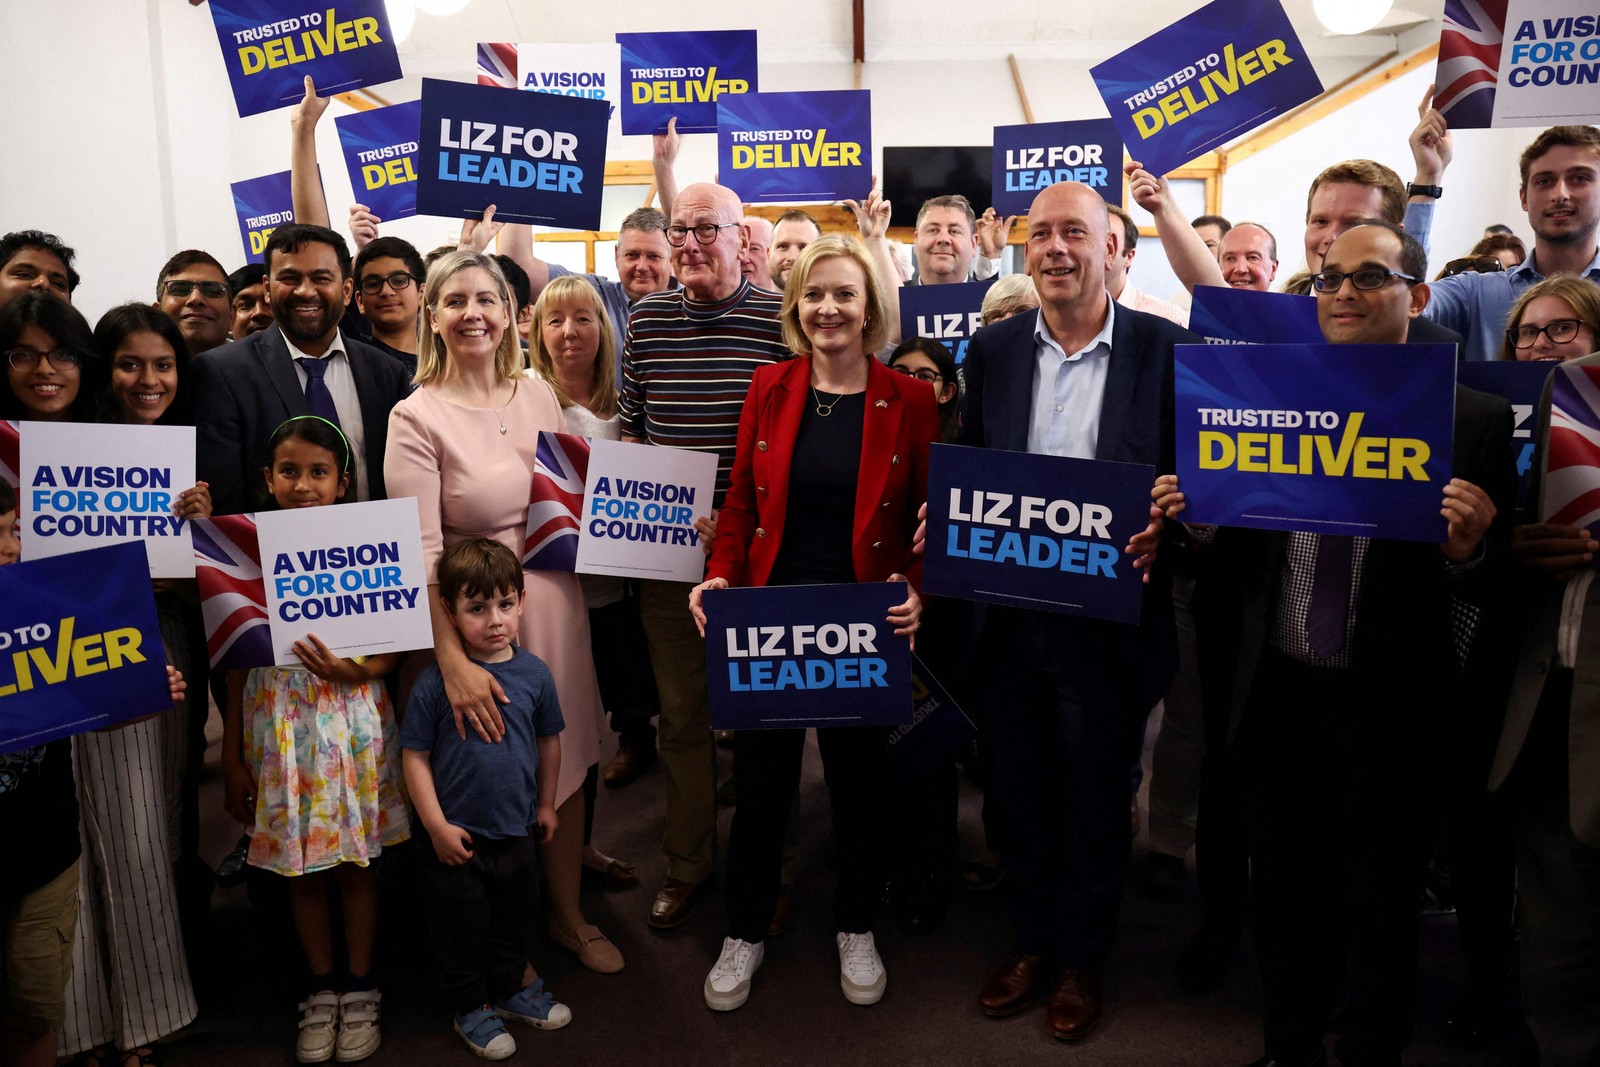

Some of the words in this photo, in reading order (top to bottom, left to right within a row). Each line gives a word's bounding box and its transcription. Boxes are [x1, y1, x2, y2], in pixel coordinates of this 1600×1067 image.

[233, 18, 300, 44] TRUSTED
[301, 12, 322, 28] TO
[238, 8, 383, 75] DELIVER
[1513, 20, 1537, 41] A
[1511, 41, 1576, 64] FOR
[524, 72, 539, 87] A
[541, 72, 605, 87] VISION
[630, 67, 686, 79] TRUSTED
[687, 66, 705, 78] TO
[1124, 66, 1196, 110] TRUSTED
[1195, 53, 1219, 72] TO
[1132, 39, 1293, 139] DELIVER
[439, 118, 496, 153] LIZ
[502, 126, 578, 162] FOR
[731, 130, 793, 142] TRUSTED
[794, 129, 813, 140] TO
[732, 129, 862, 169] DELIVER
[357, 141, 419, 163] TRUSTED
[1006, 148, 1044, 170] LIZ
[1048, 144, 1103, 167] FOR
[438, 152, 584, 194] LEADER
[246, 213, 281, 229] TRUSTED
[281, 210, 293, 222] TO
[916, 313, 964, 339] LIZ
[1198, 408, 1301, 428] TRUSTED
[1301, 410, 1340, 430] TO
[1199, 412, 1431, 481] DELIVER
[32, 465, 58, 487] A
[61, 466, 171, 488] VISION
[594, 476, 612, 496] A
[616, 478, 695, 505] VISION
[32, 490, 100, 513] FOR
[103, 490, 172, 513] OUR
[590, 498, 640, 520] FOR
[643, 503, 692, 526] OUR
[948, 487, 1013, 527] LIZ
[1019, 495, 1113, 539] FOR
[32, 514, 185, 537] COUNTRY
[588, 519, 700, 547] COUNTRY
[273, 552, 296, 575] A
[296, 541, 400, 572] VISION
[946, 524, 1119, 579] LEADER
[275, 573, 337, 599] FOR
[339, 566, 403, 592] OUR
[278, 587, 420, 623] COUNTRY
[14, 623, 51, 645] TO
[726, 626, 787, 657] LIZ
[793, 623, 878, 655] FOR
[728, 658, 889, 692] LEADER
[888, 729, 904, 745] TO
